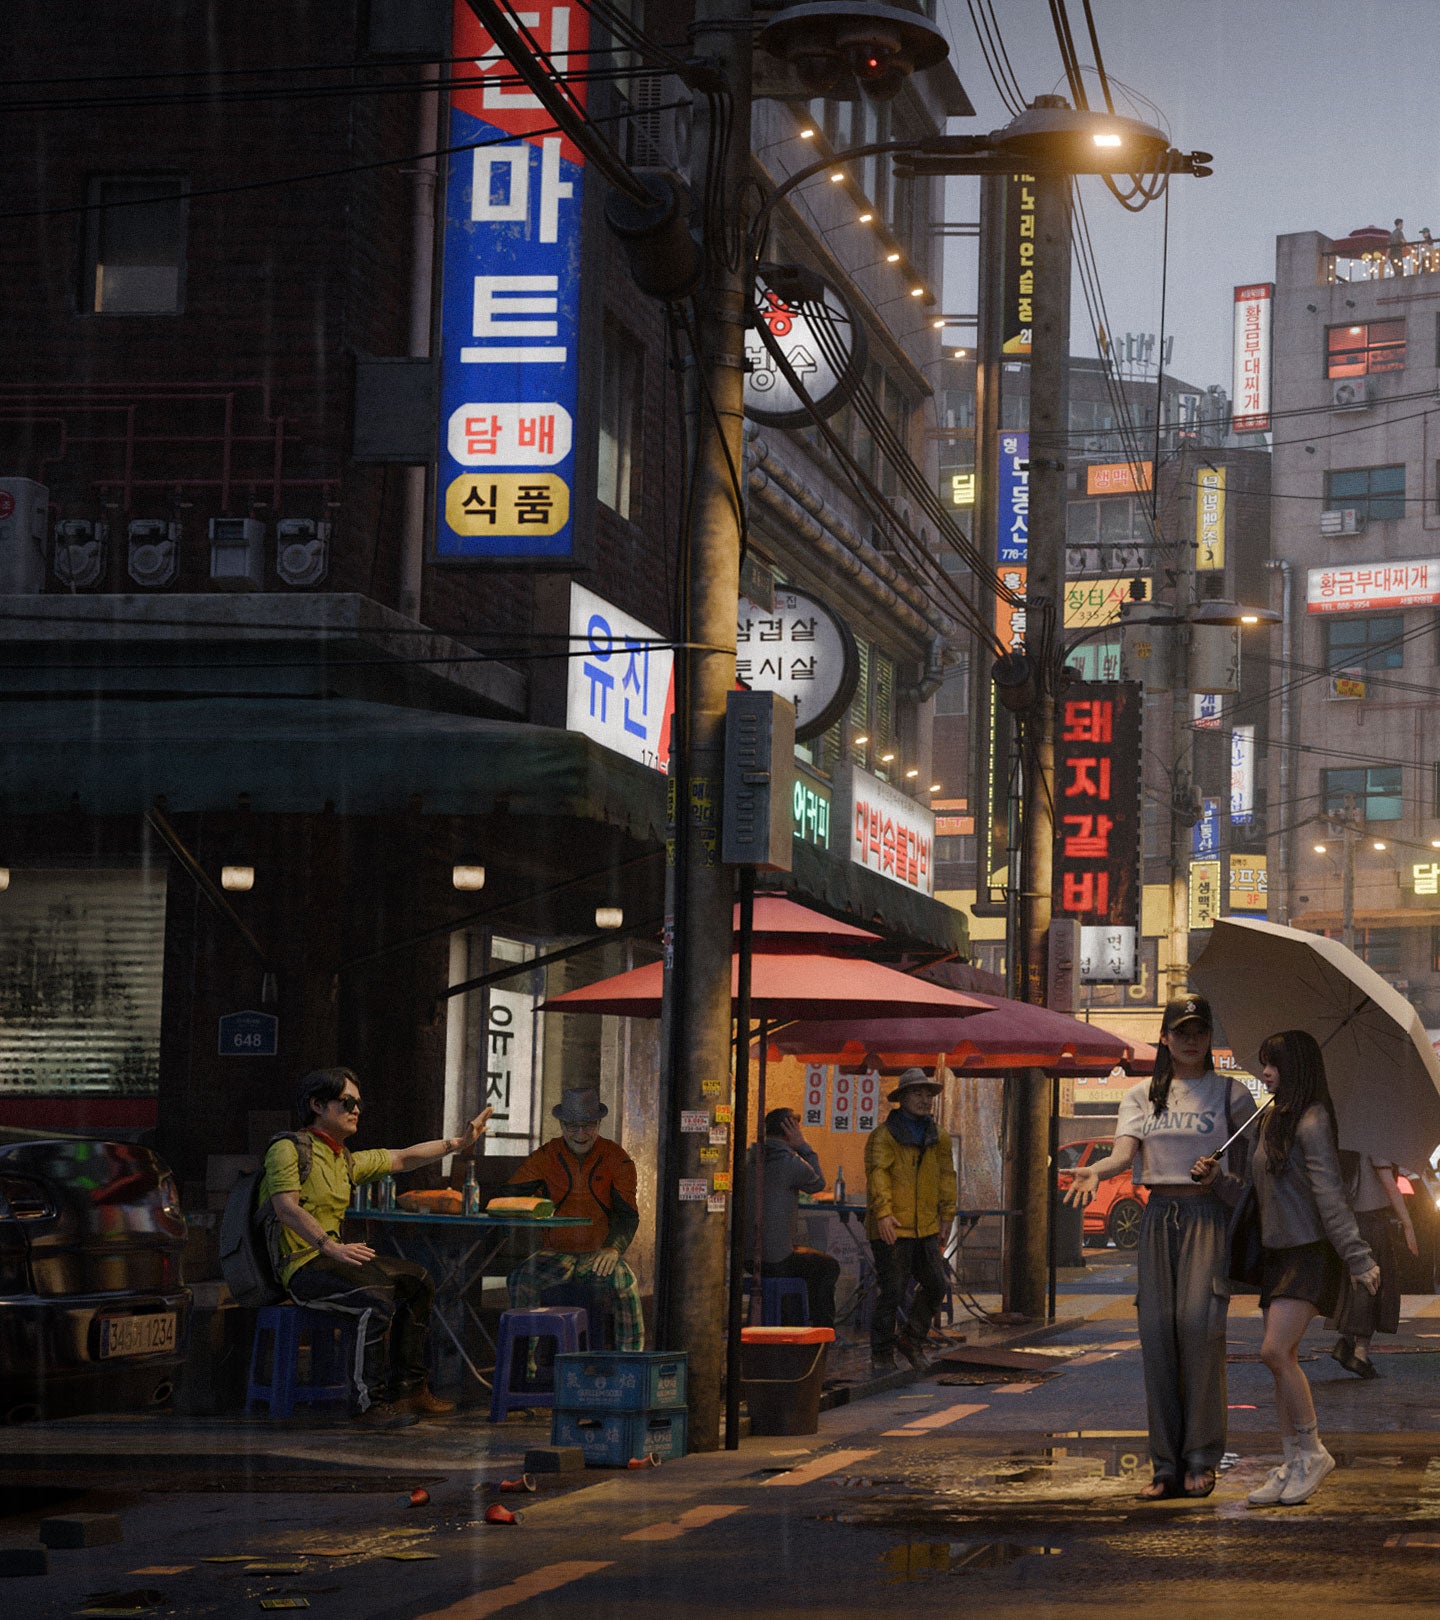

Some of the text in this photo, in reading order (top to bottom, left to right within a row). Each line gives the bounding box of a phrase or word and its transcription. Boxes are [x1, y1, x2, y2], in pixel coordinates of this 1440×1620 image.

[1244, 303, 1262, 410] 황금부대찌개
[464, 415, 554, 455] 담배
[462, 484, 554, 525] 식품
[1069, 586, 1136, 610] 장터식
[1319, 565, 1428, 597] 황금부대찌개
[581, 613, 649, 741] 유진
[1061, 699, 1114, 915] 돼지갈비
[855, 800, 931, 893] 대박숯불갈비
[1198, 882, 1210, 922] 생맥주
[1247, 893, 1260, 905] 3F
[234, 1033, 262, 1048] 648
[835, 1073, 849, 1130] 00원
[1142, 1109, 1217, 1135] GIANTS
